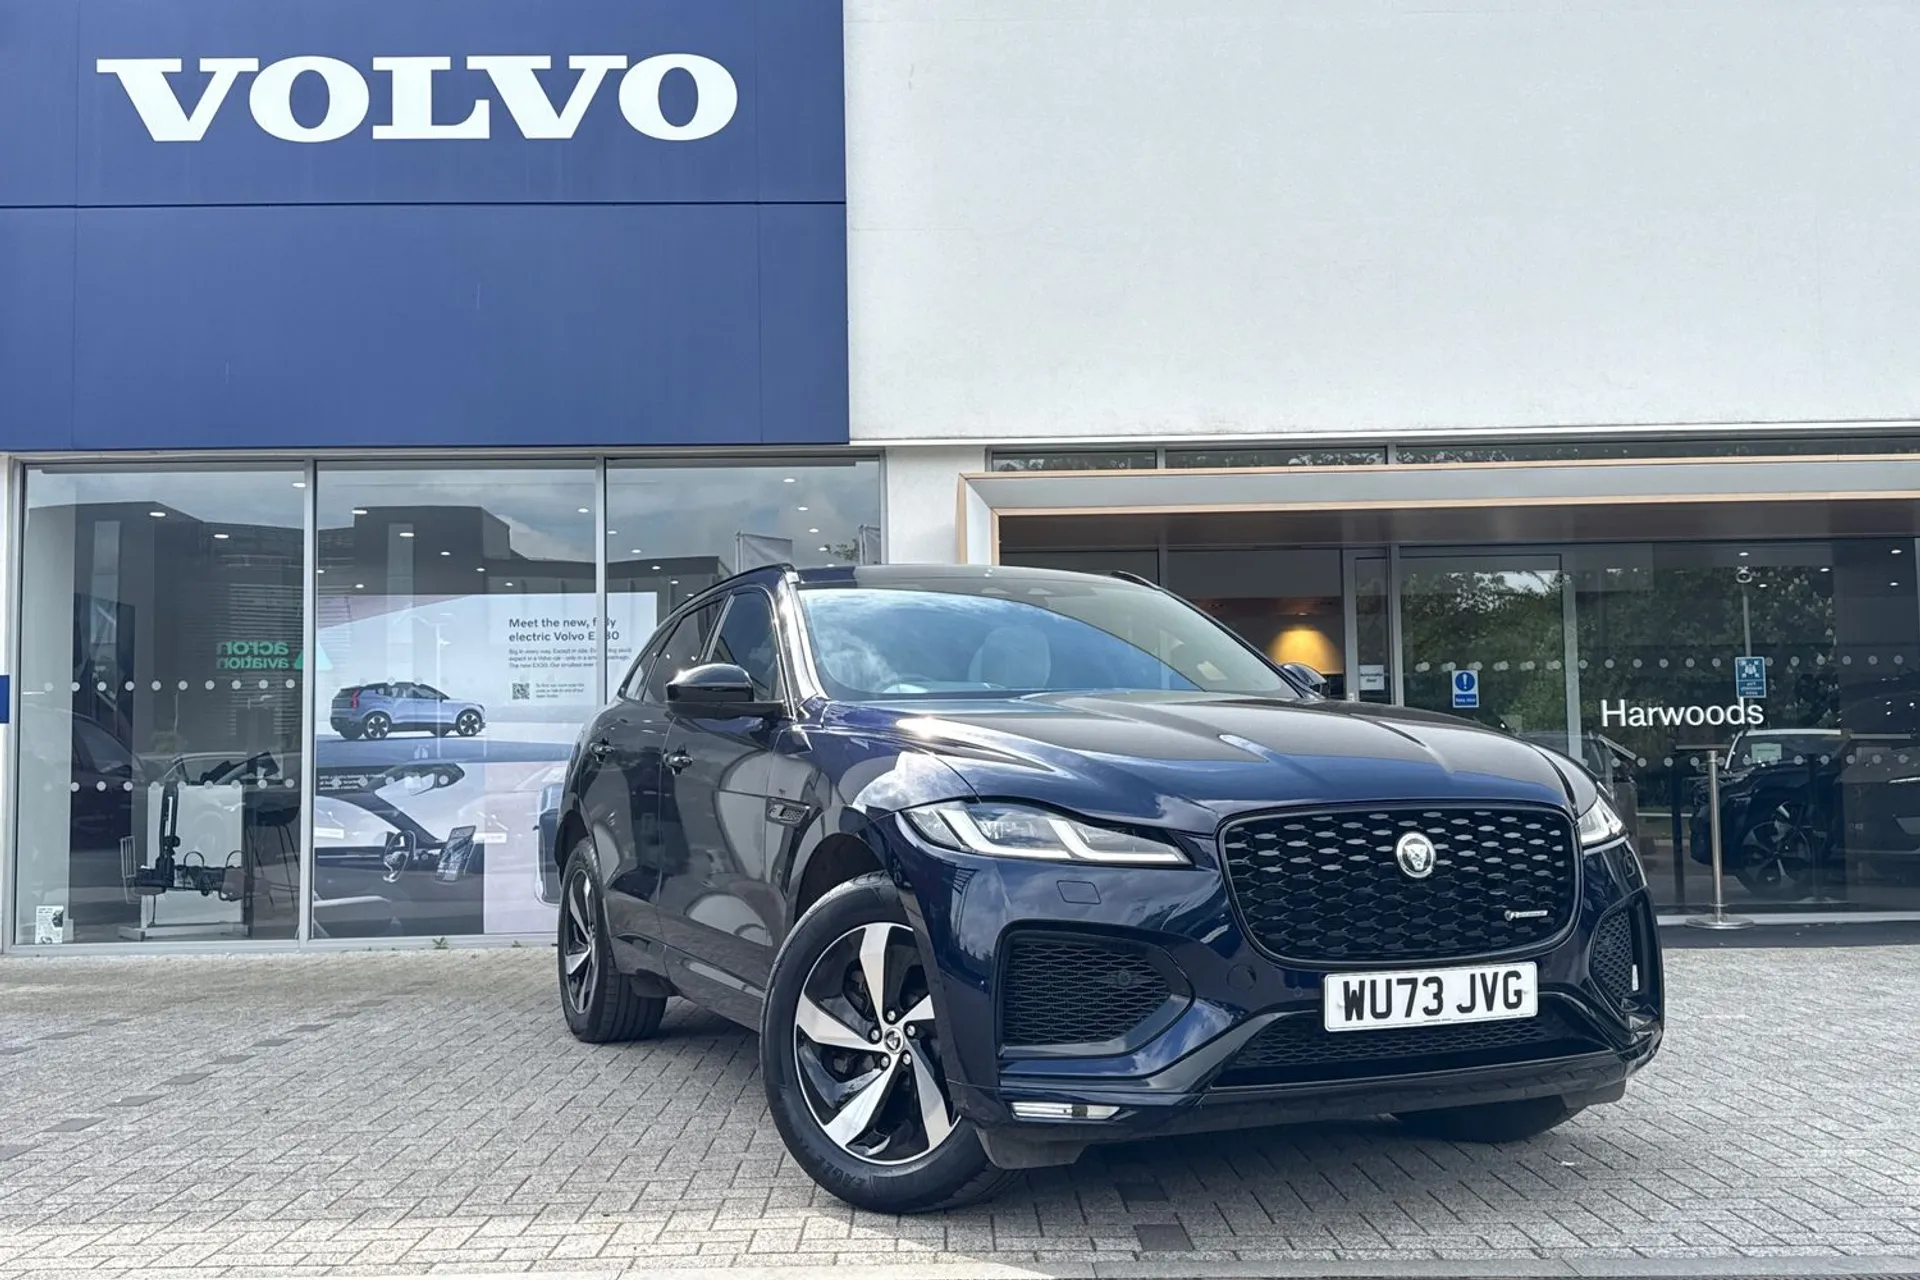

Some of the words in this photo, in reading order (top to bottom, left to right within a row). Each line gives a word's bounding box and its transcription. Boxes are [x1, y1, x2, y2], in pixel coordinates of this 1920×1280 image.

[97, 53, 738, 143] VOLVO
[509, 618, 538, 628] Meet
[541, 618, 560, 628] the
[563, 619, 589, 629] new,
[509, 632, 551, 642] electric
[553, 631, 585, 641] Volvo
[588, 631, 620, 641] E30
[1601, 698, 1764, 727] Harwoods
[1343, 976, 1444, 1021] WU73
[1456, 970, 1522, 1014] JVG
